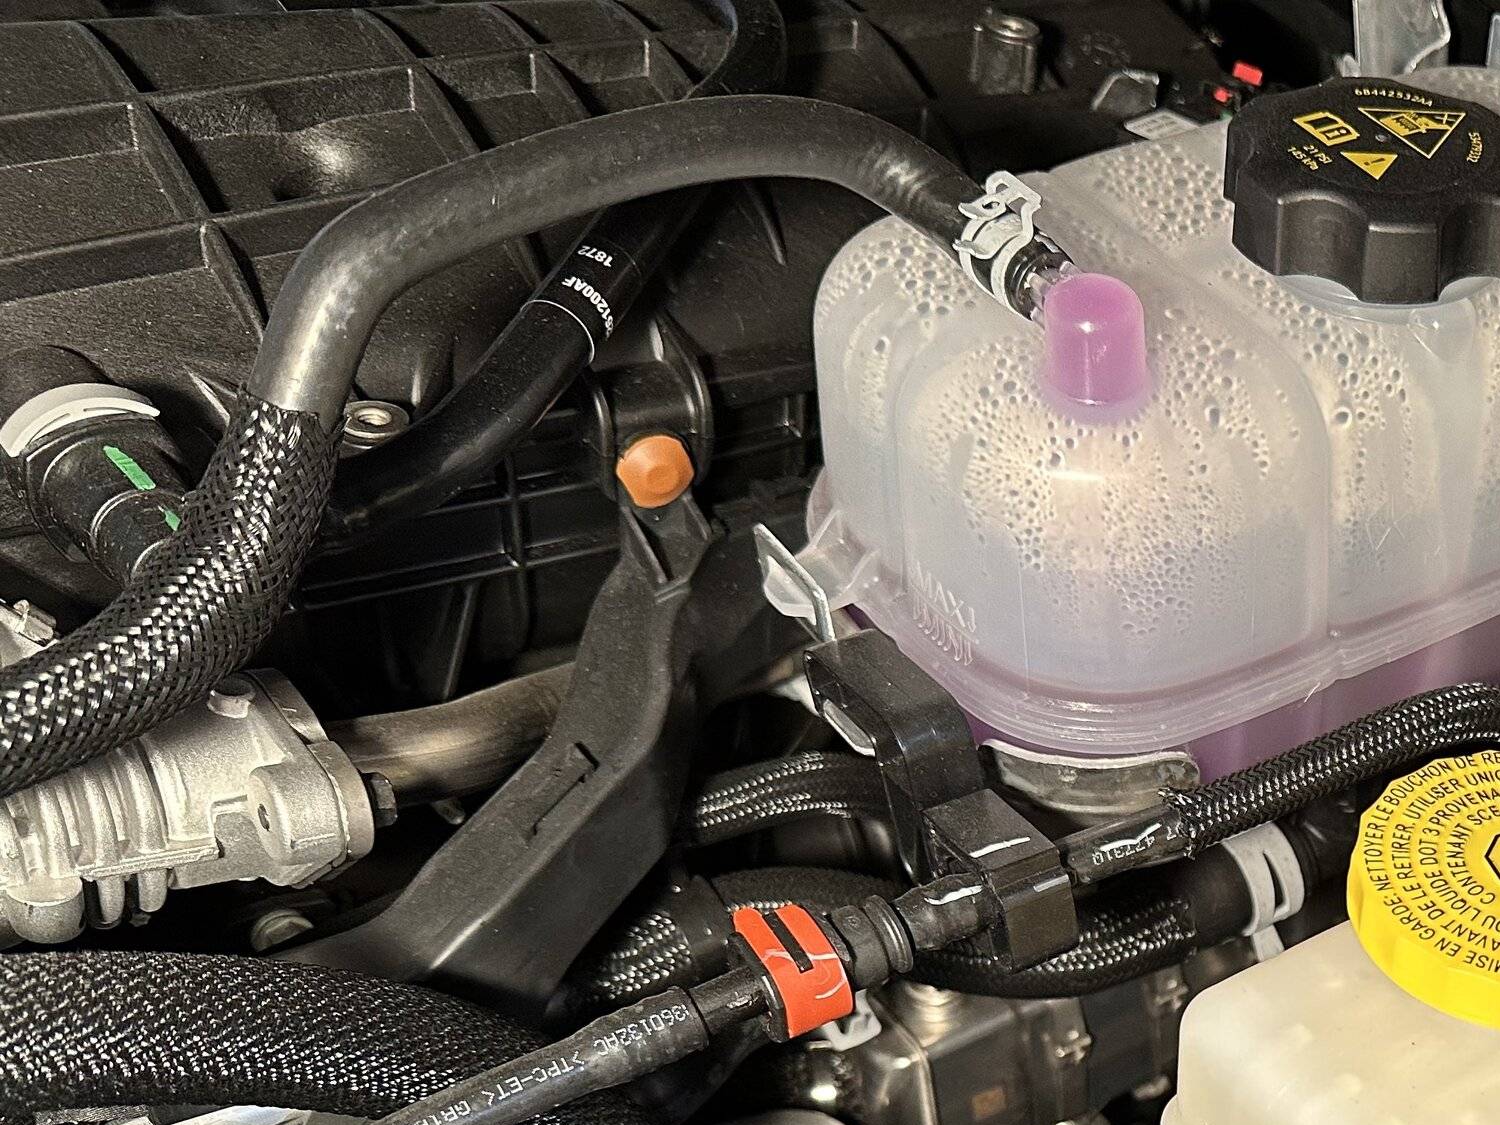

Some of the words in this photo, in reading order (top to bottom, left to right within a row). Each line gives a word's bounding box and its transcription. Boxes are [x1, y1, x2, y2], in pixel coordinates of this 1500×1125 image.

[1302, 144, 1317, 155] 21
[1315, 151, 1332, 164] PSI
[577, 245, 613, 268] 1872
[1453, 755, 1478, 769] DE
[1383, 761, 1453, 807] BOUCHON
[1403, 778, 1466, 821] UTILISER
[1371, 804, 1394, 822] LE
[1422, 827, 1441, 837] 3
[1363, 822, 1394, 892] NETTOYER
[1391, 822, 1417, 880] RETIRER.
[1418, 839, 1439, 865] DOT
[1446, 823, 1496, 905] CONTENANT
[1402, 882, 1428, 901] LE
[1423, 870, 1482, 922] LIQUIDE
[1383, 892, 1436, 940] GARDE:
[1417, 900, 1446, 920] DE
[1434, 937, 1462, 957] EN
